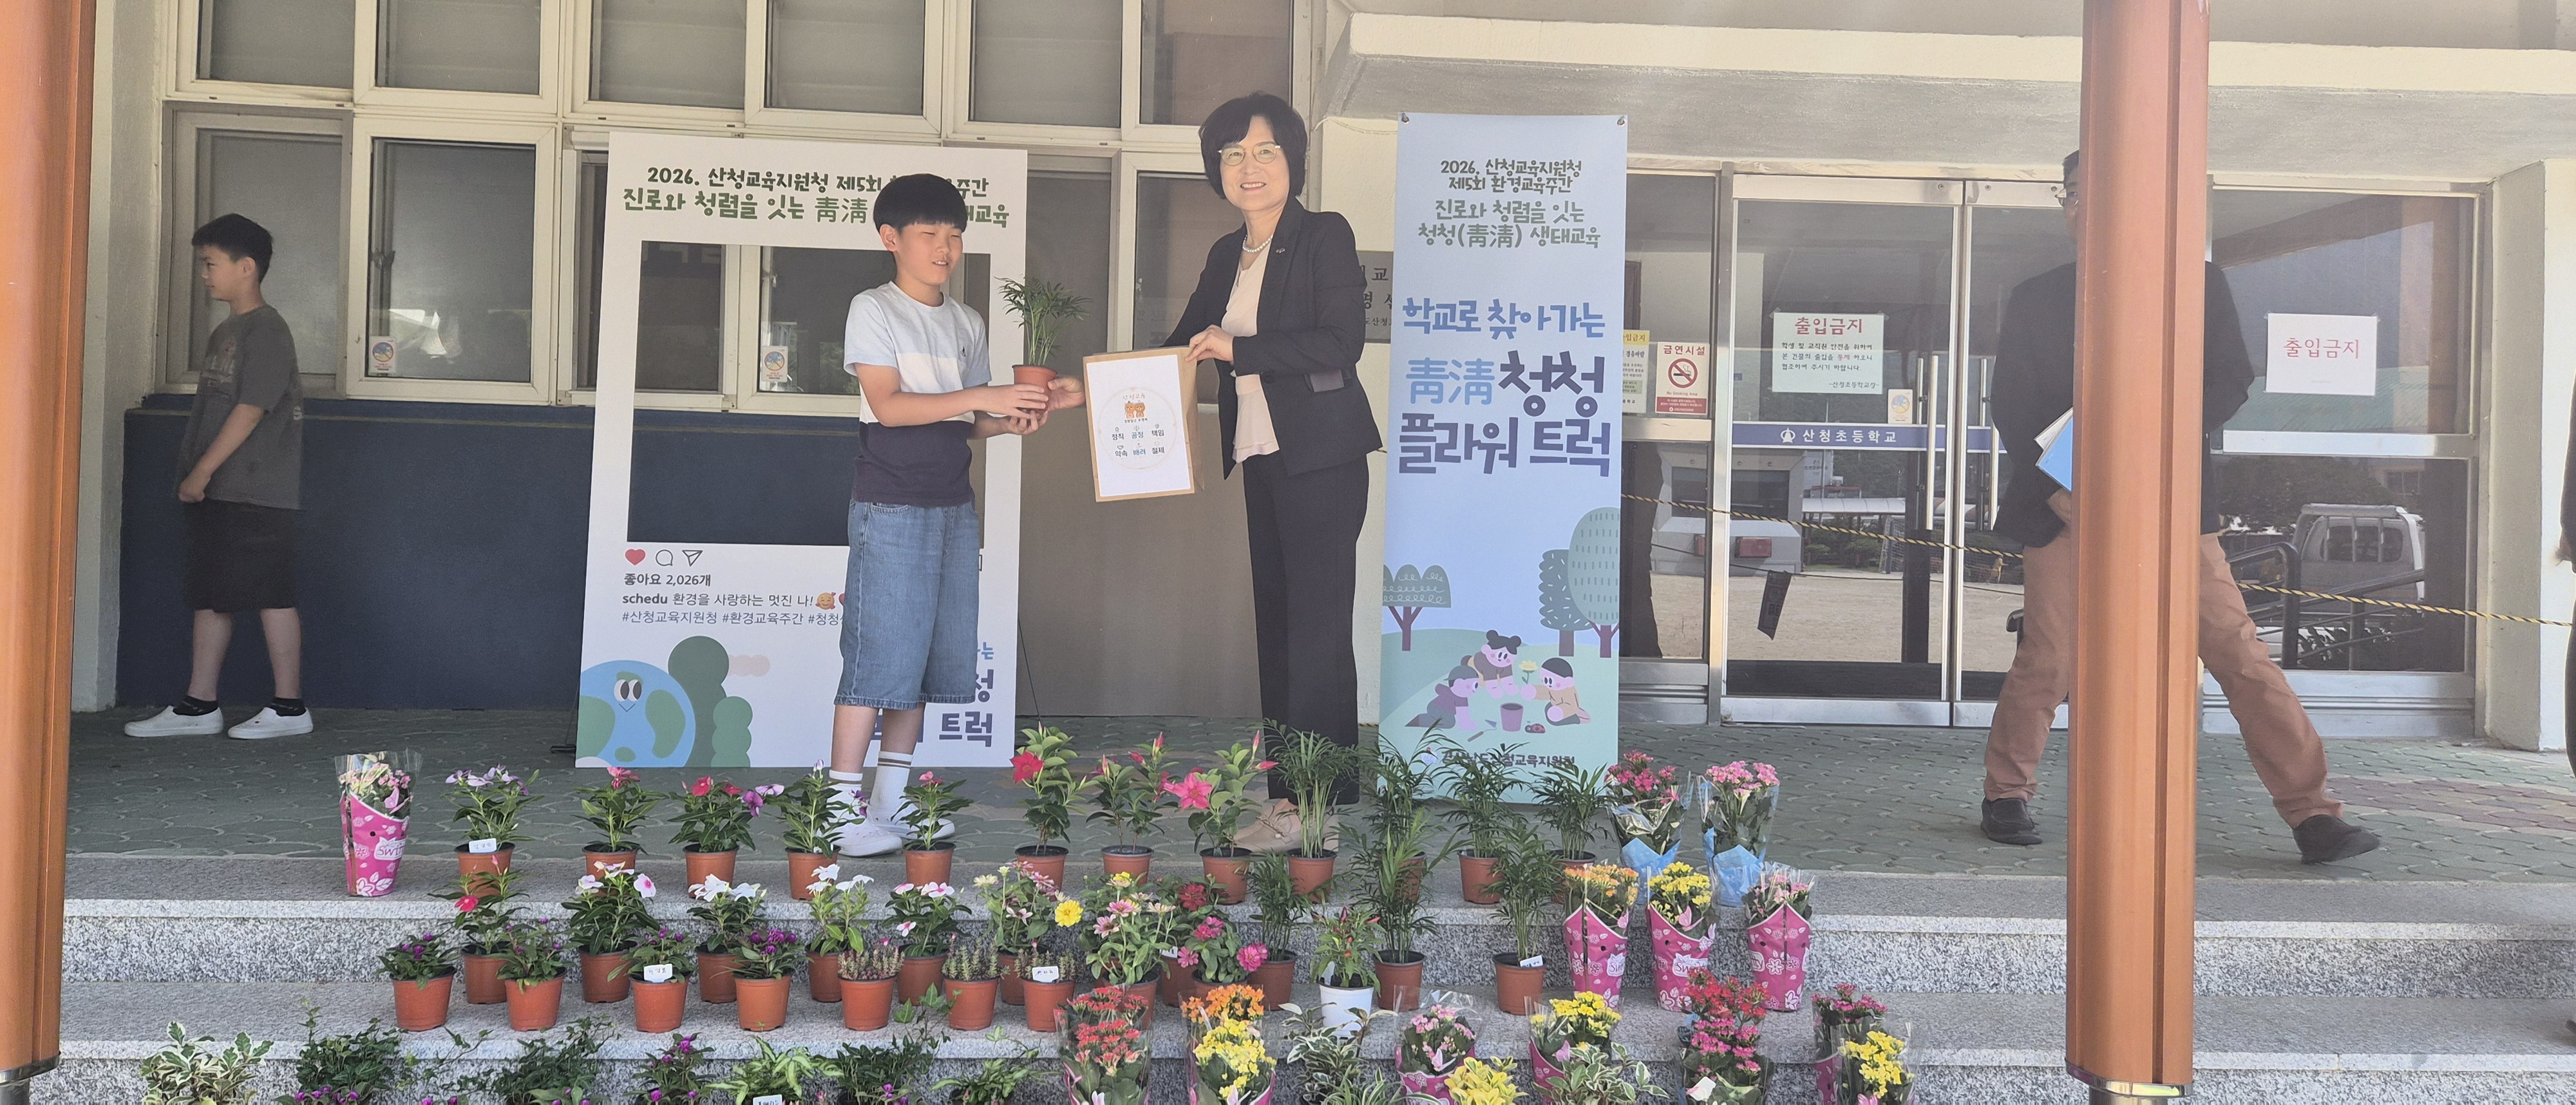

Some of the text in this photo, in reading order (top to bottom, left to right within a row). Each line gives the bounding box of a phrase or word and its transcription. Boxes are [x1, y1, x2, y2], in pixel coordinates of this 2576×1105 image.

[1441, 158, 1582, 178] 2026. 산청교육지원청
[647, 167, 700, 186] 2026.
[708, 167, 829, 193] 산청교육지원청
[1448, 175, 1573, 195] 제5회 환경교육주간
[623, 187, 687, 211] 진로와
[694, 190, 758, 220] 청렴을
[767, 194, 805, 220] 잇는
[1435, 199, 1585, 224] 진로와 청렴을 잇는
[1530, 226, 1602, 249] 생태교육
[1403, 297, 1605, 340] 학교로 찾아가는
[1795, 317, 1862, 335] 출입금지
[1624, 334, 1645, 342] 입금지
[2283, 337, 2358, 359] 출입금지
[1663, 345, 1705, 355] 금연시설
[1498, 350, 1605, 418] 청청
[1399, 413, 1611, 477] 플라워 트럭
[1803, 429, 1897, 443] 산청초등학교
[623, 573, 712, 587] 좋아요 2,026개
[622, 593, 668, 604] schedu
[672, 593, 710, 606] 환경을
[714, 593, 764, 607] 사랑하는
[768, 594, 792, 607] 멋진
[622, 611, 717, 625] #산청교육지원청
[722, 612, 804, 625] #환경교육주간
[939, 712, 993, 747] 트럭
